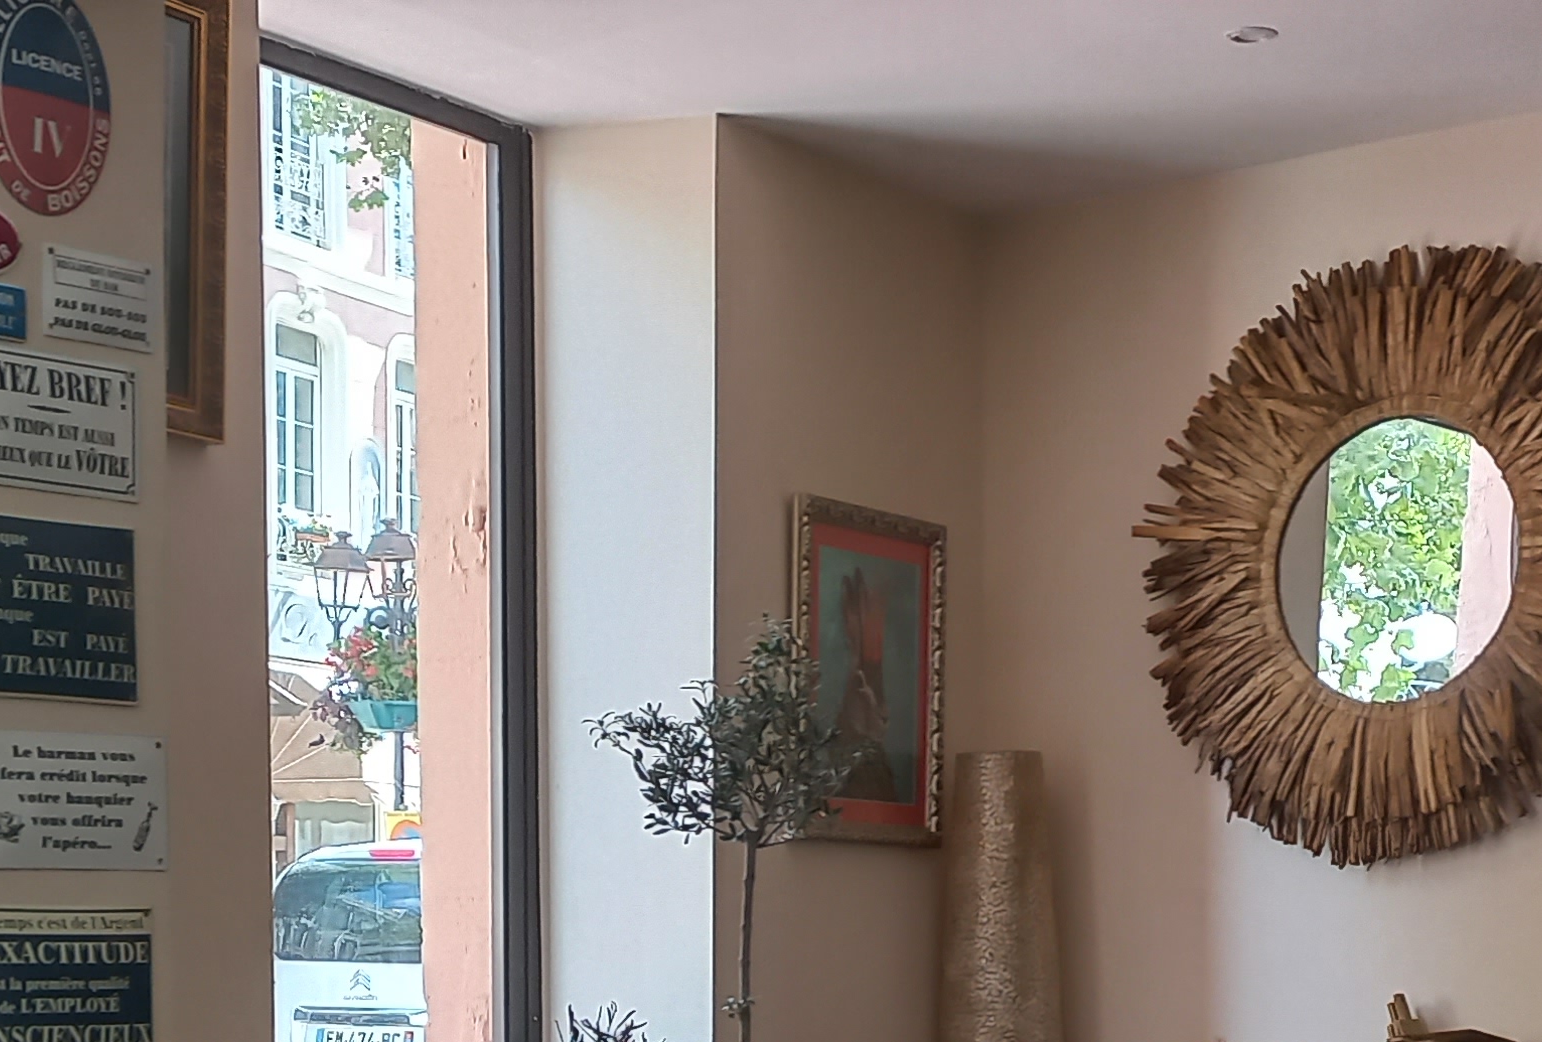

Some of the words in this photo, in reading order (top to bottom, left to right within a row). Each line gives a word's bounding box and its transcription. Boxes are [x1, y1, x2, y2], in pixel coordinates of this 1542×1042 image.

[11, 48, 83, 82] LICENCE
[33, 116, 72, 158] IV
[11, 179, 32, 201] DE
[47, 118, 110, 212] BOISSONS
[54, 298, 78, 311] PAS
[47, 368, 112, 407] BREF
[119, 380, 128, 411] !
[13, 417, 56, 438] TEMPS
[58, 423, 79, 442] EST
[82, 428, 115, 447] AUSSI
[28, 450, 54, 468] QUE
[57, 453, 72, 470] LE
[74, 446, 130, 478] VÔTRE
[23, 552, 127, 581] TRAVAILLE
[11, 573, 73, 603] ÊTRE
[86, 585, 135, 611] PAYÉ
[31, 628, 70, 649] EST
[85, 632, 130, 655] PAYÉ
[1, 653, 138, 684] TRAVAILLER
[12, 745, 32, 759] Le
[36, 746, 97, 761] barman
[101, 750, 137, 762] vous
[0, 767, 36, 781] fera
[39, 768, 88, 783] crédit
[91, 770, 148, 787] lorsque
[17, 791, 62, 805] votre
[66, 792, 135, 808] banquier
[30, 815, 68, 827] vous
[71, 814, 124, 828] offrira
[70, 916, 89, 930] de
[9, 976, 23, 991] la
[24, 976, 87, 993] première
[87, 975, 131, 993] qualité
[19, 992, 121, 1014] L'EMPLOYÉ
